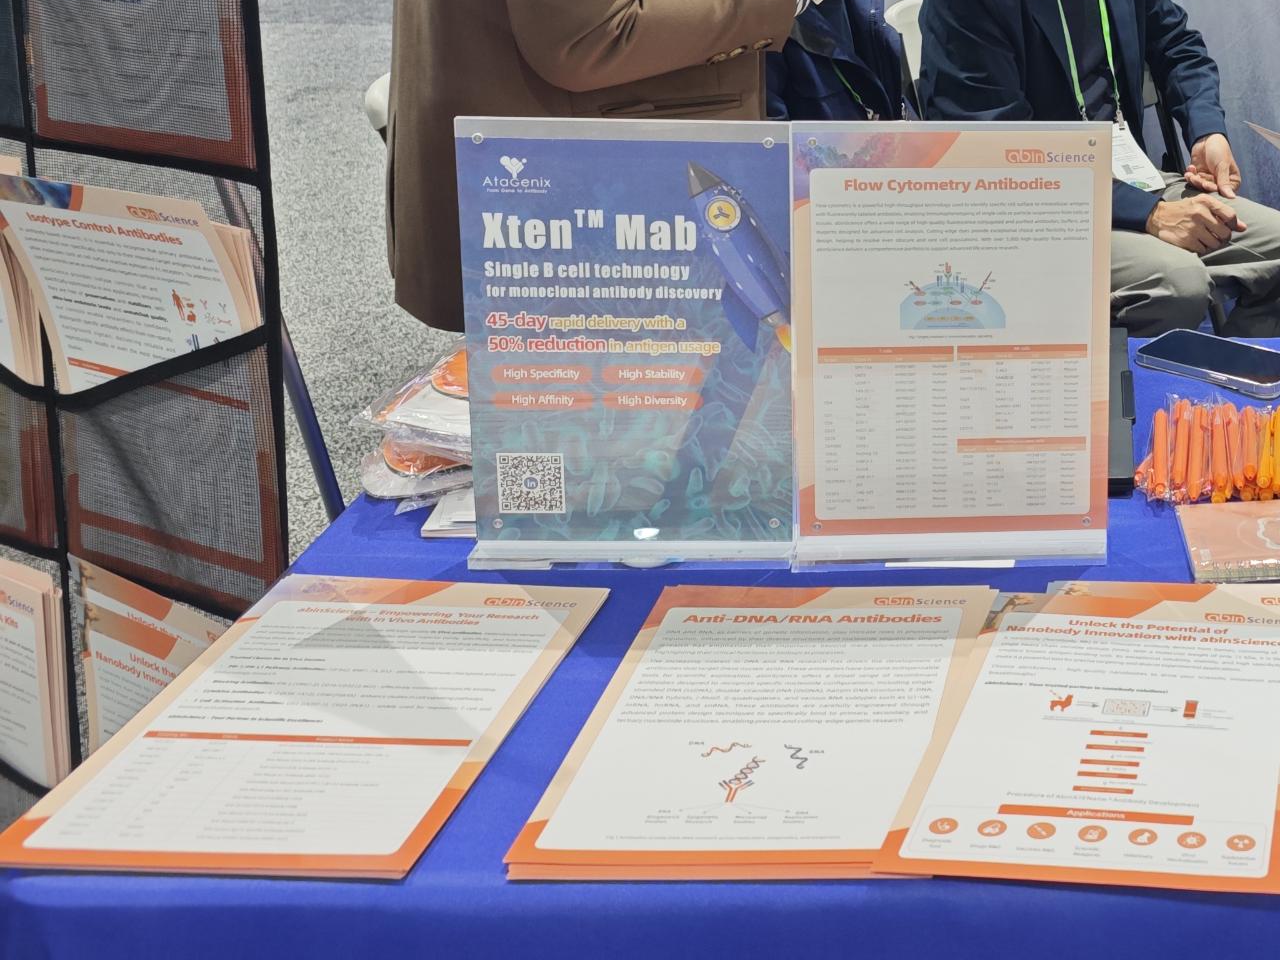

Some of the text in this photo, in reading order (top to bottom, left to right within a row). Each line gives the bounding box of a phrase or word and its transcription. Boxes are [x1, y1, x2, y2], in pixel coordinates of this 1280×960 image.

[1005, 149, 1095, 163] abinScience
[483, 176, 551, 187] AtaGenix
[844, 178, 1061, 193] Flow Cytometry Antibodies
[26, 213, 183, 245] Isotype Control Antibodies
[616, 215, 696, 251] Mab
[484, 262, 689, 281] Single B cell technology
[487, 285, 722, 300] for monoclonal antibody discovery
[486, 312, 686, 330] 45-day rapid delivery with a
[487, 336, 720, 356] 50% reduction in antigen usage
[504, 368, 580, 380] High Specificity
[619, 369, 685, 380] High Stability
[512, 395, 574, 406] High Affinity
[618, 396, 687, 407] High Diversity
[683, 614, 942, 624] Anti-DNA/RNA Antibodies
